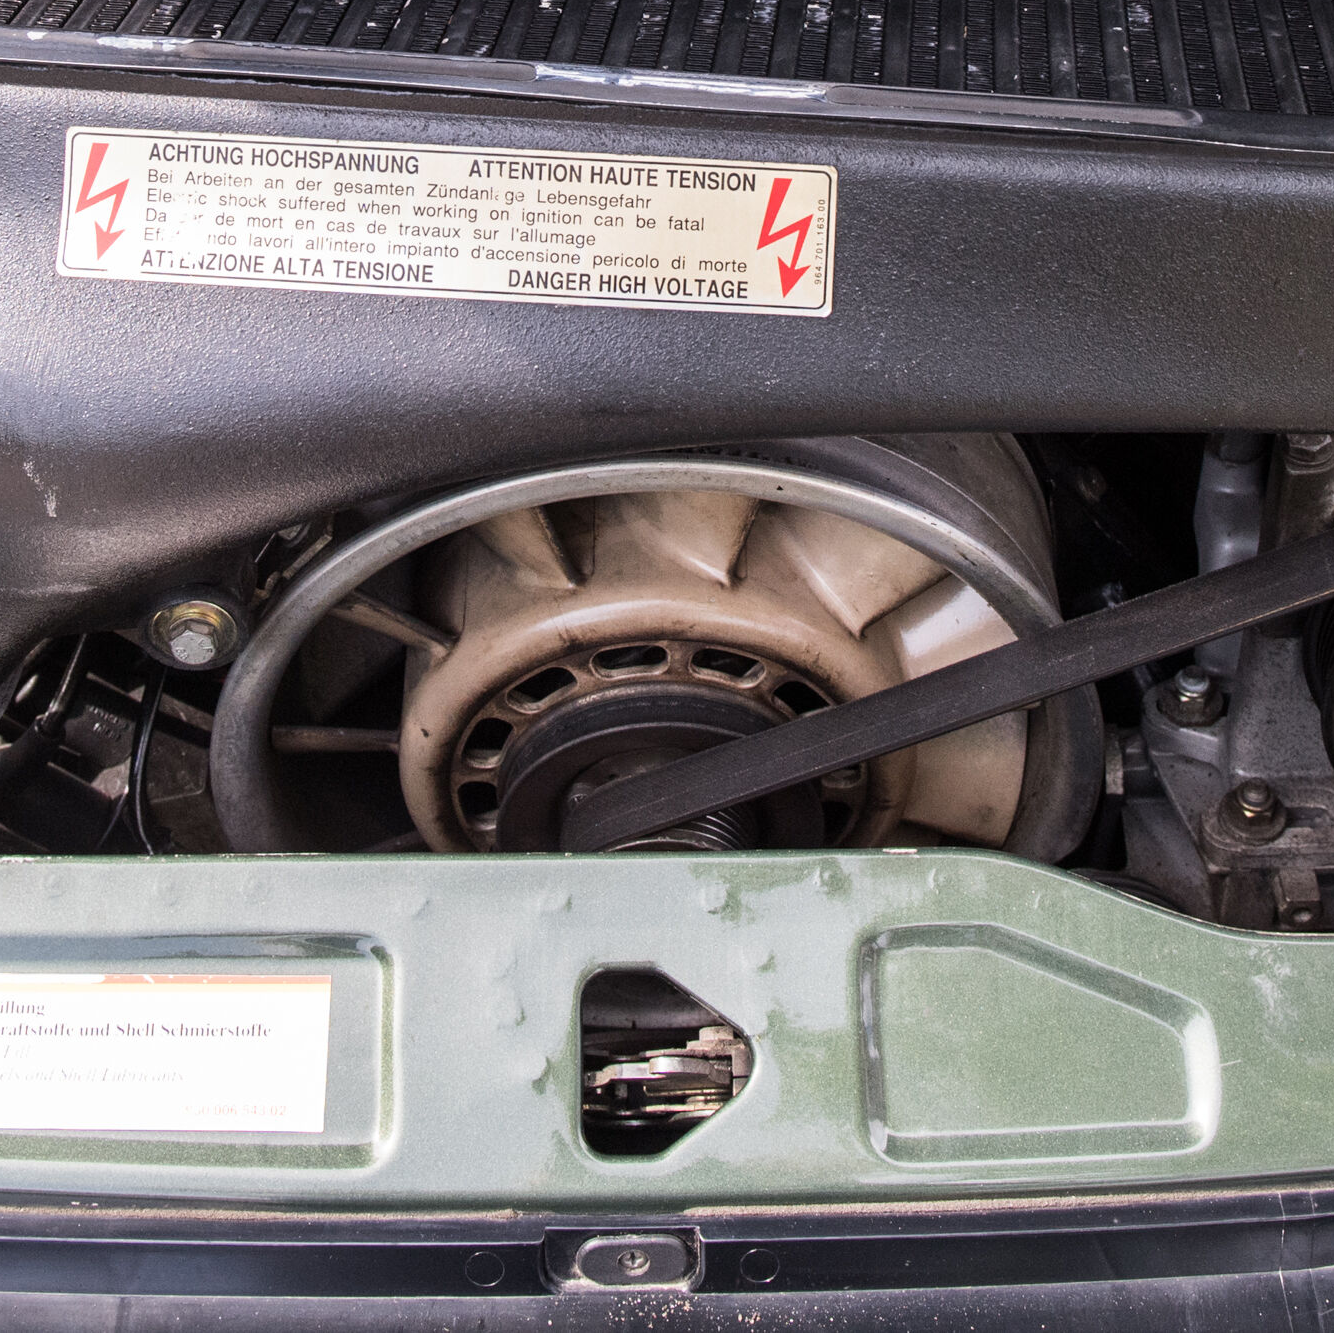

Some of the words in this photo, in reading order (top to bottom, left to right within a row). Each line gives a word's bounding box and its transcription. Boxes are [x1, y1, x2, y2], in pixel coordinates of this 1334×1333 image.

[148, 143, 244, 166] ACHTUNG
[251, 148, 420, 175] HOCHSPANNUNG
[468, 159, 583, 184] ATTENTION
[589, 165, 659, 188] HAUTE
[667, 169, 757, 193] TENSION
[147, 168, 173, 184] Bei
[184, 171, 253, 188] Arbeiten
[263, 176, 285, 190] an
[295, 177, 323, 192] der
[333, 180, 416, 198] gesamten
[536, 188, 653, 210] Lebensgefahr
[218, 193, 267, 209] shock
[278, 196, 347, 214] suffered
[357, 201, 402, 216] when
[412, 204, 479, 222] working
[489, 209, 510, 221] on
[521, 208, 585, 230] ignition
[594, 215, 625, 228] can
[635, 215, 657, 230] be
[668, 215, 705, 232] fatal
[215, 213, 235, 226] de
[247, 215, 284, 230] mort
[295, 218, 315, 231] en
[326, 220, 355, 233] cas
[366, 220, 387, 235] de
[398, 222, 462, 239] travaux
[473, 228, 499, 242] sur
[510, 227, 597, 247] l'allumage
[248, 233, 294, 249] lavori
[305, 237, 377, 255] all'intero
[387, 243, 460, 260] impianto
[470, 245, 582, 266] d'accensione
[592, 253, 660, 271] pericolo
[670, 255, 686, 271] di
[698, 258, 748, 273] morte
[272, 256, 325, 278] ALTA
[333, 259, 435, 284] TENSIONE
[508, 269, 592, 293] DANGER
[598, 274, 647, 295] HIGH
[653, 276, 749, 300] VOLTAGE
[79, 1022, 110, 1037] und
[116, 1022, 155, 1037] Shell
[160, 1022, 271, 1037] Schmierstoffe
